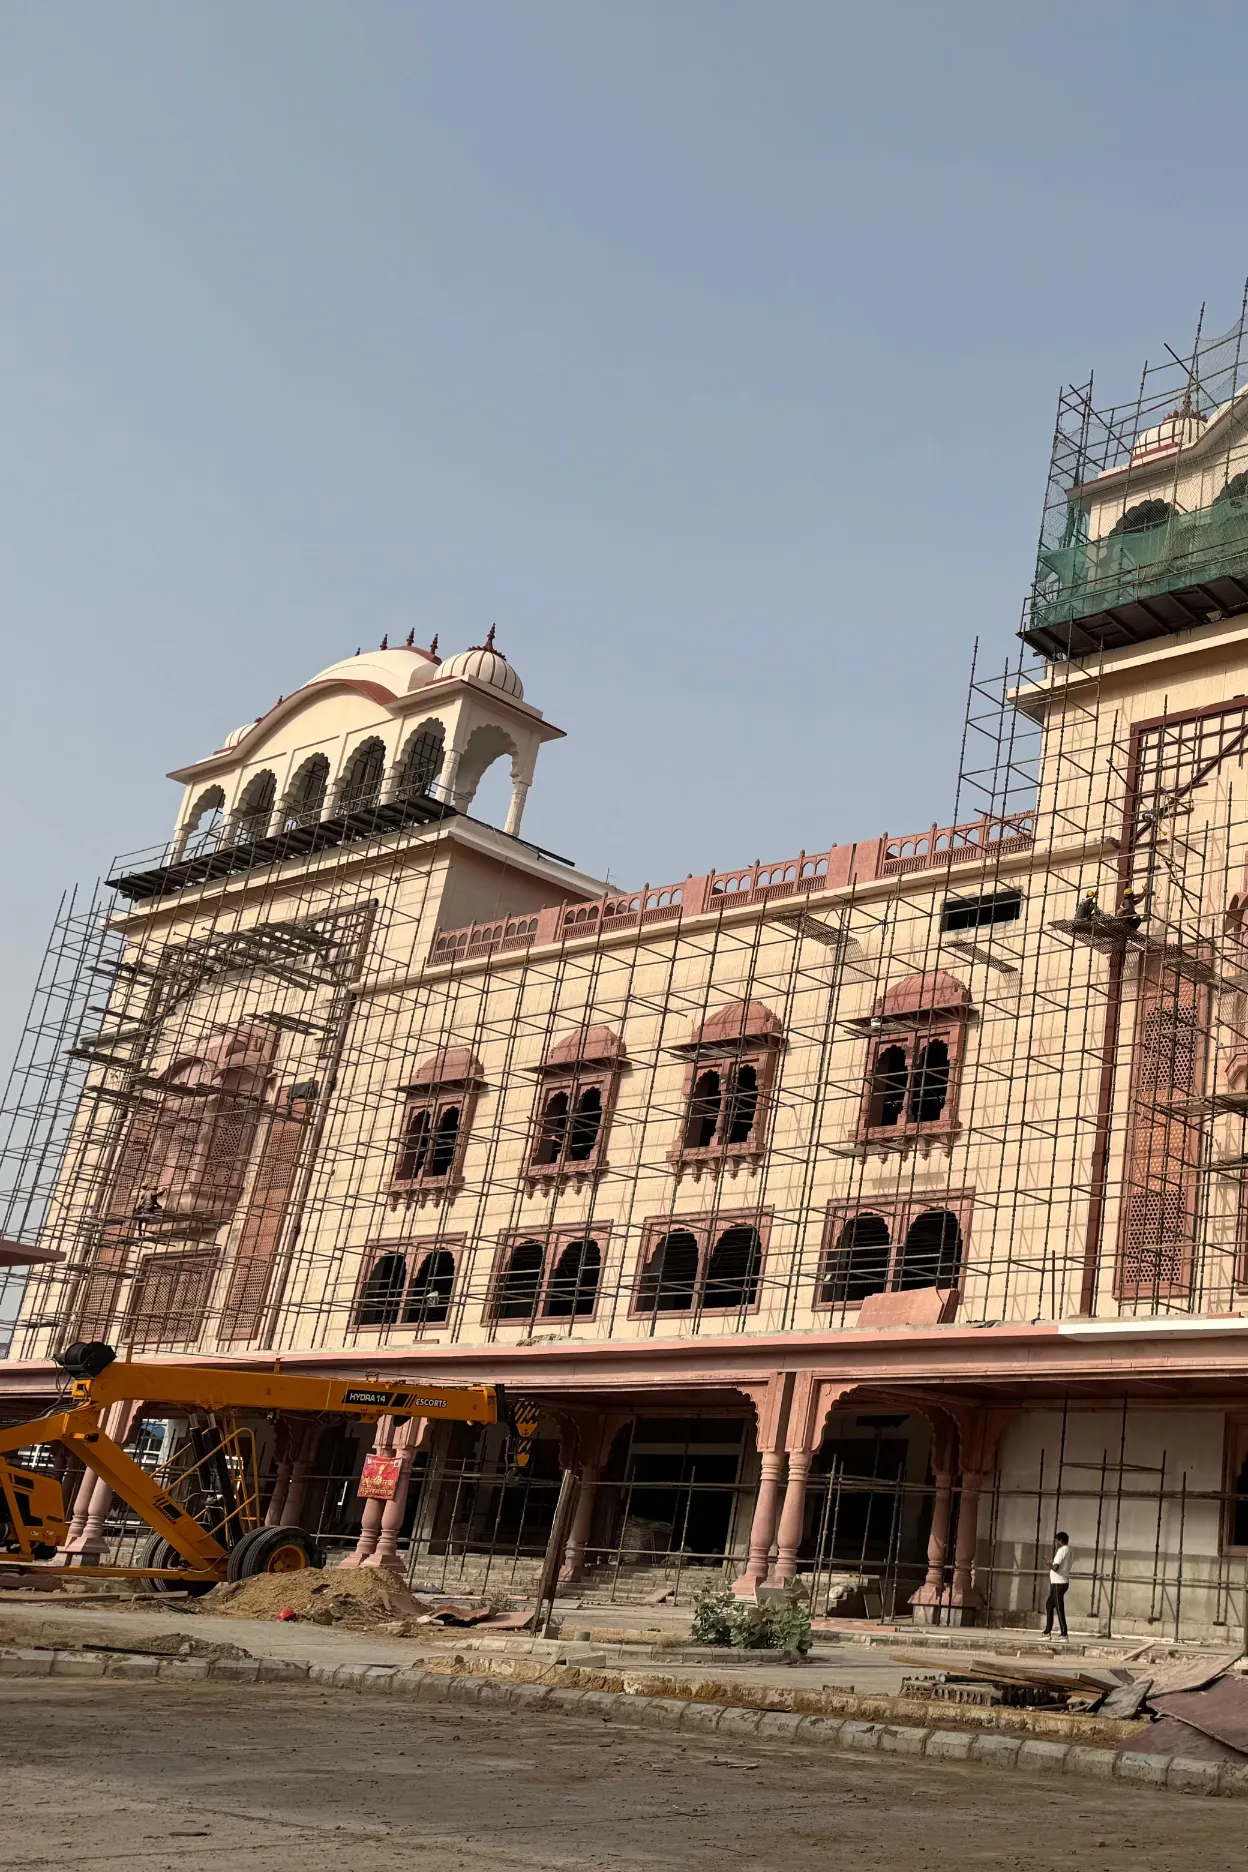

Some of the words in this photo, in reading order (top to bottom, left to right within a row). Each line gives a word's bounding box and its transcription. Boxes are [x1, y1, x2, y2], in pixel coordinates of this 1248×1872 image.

[349, 1392, 376, 1402] HYDRA
[376, 1394, 386, 1403] 14
[415, 1397, 447, 1408] ESCORTS
